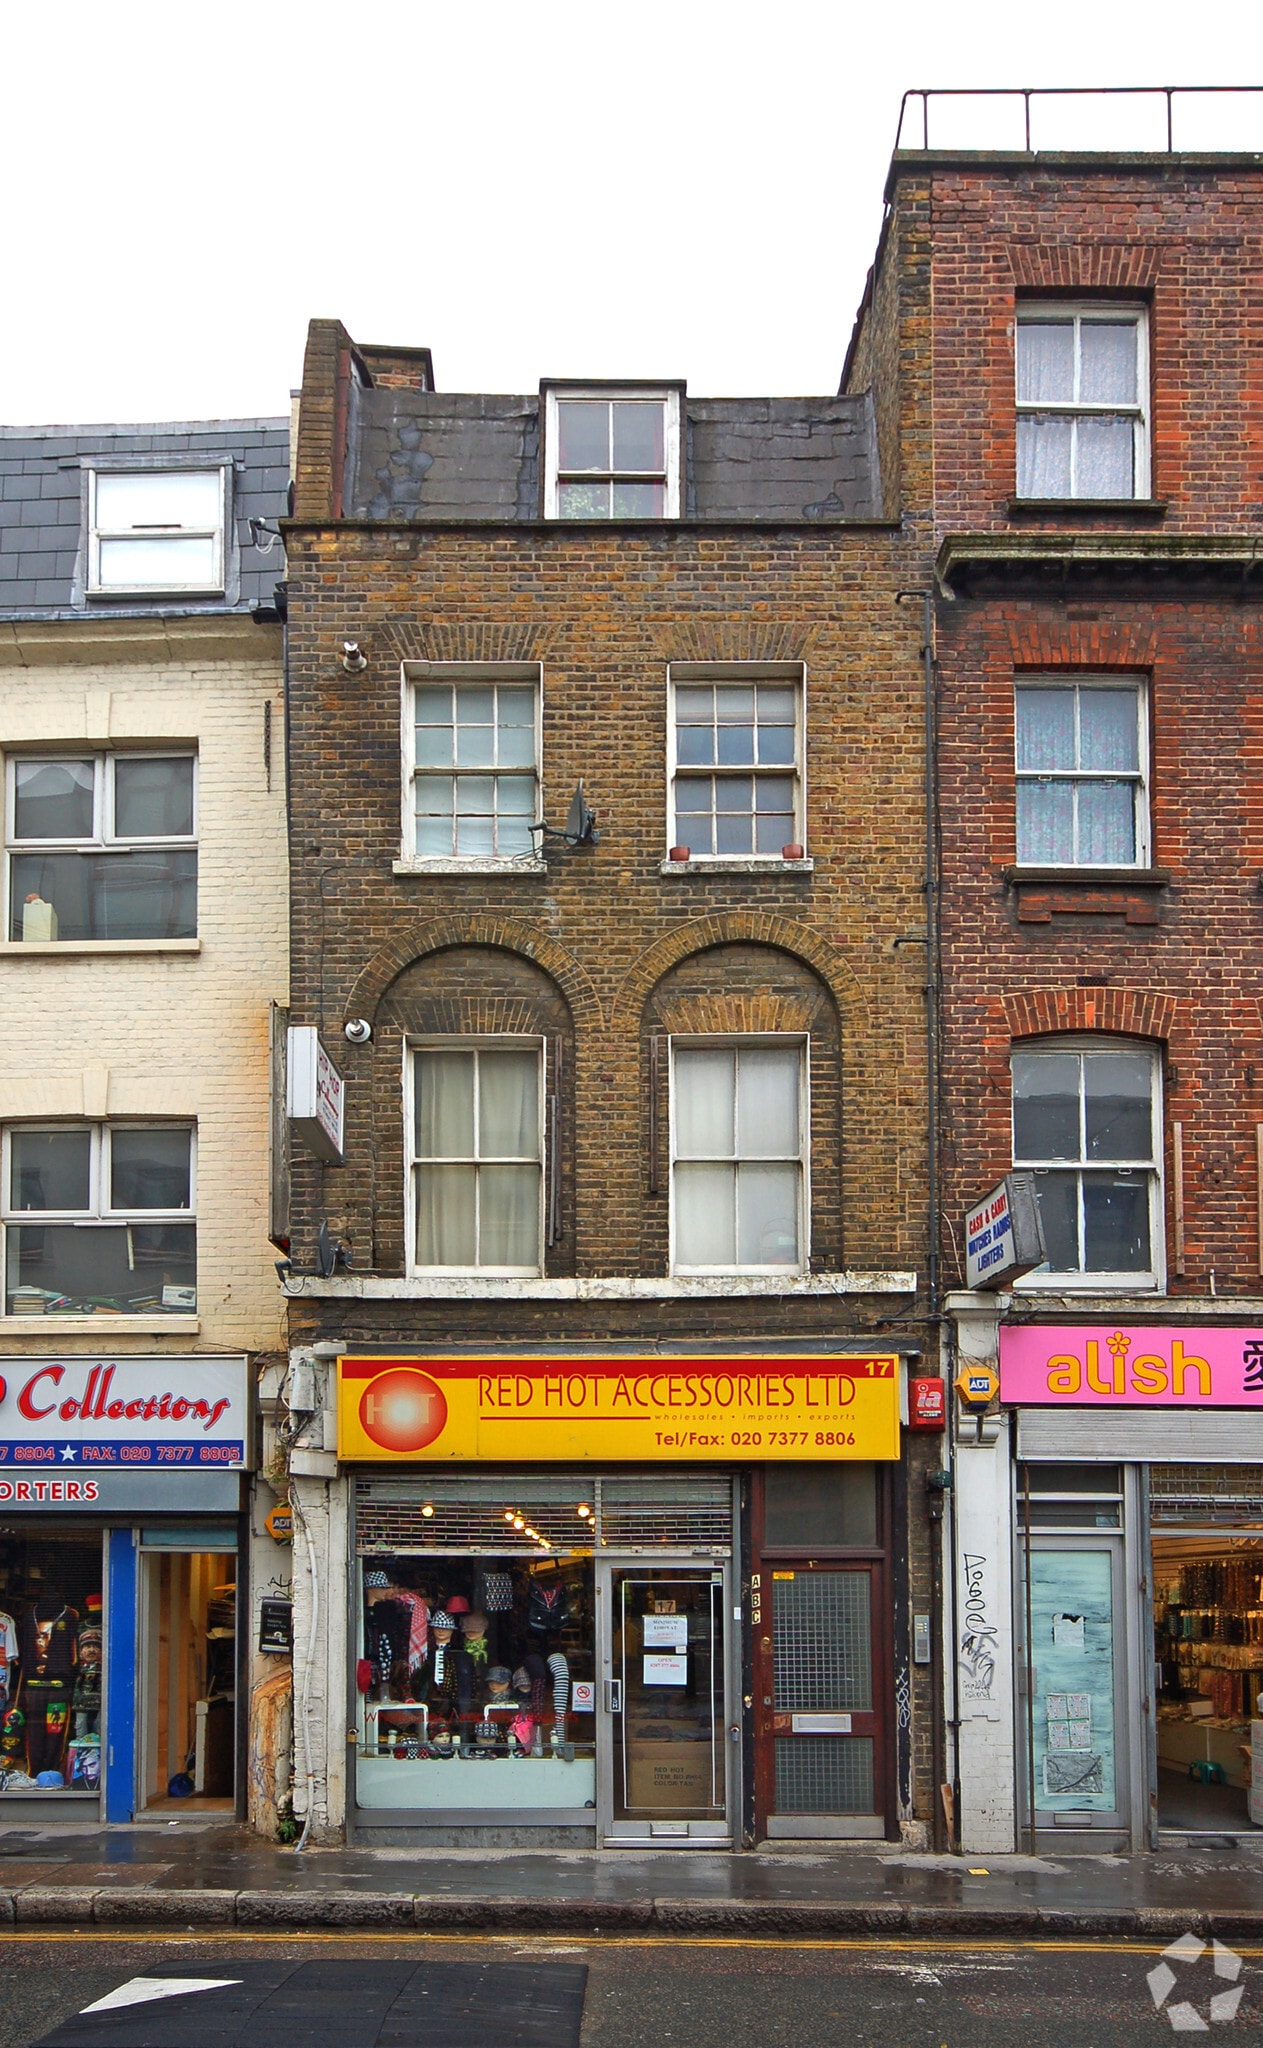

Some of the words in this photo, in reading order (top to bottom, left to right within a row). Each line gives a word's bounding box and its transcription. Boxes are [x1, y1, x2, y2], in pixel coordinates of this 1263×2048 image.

[985, 1208, 990, 1224] &
[864, 1361, 890, 1376] 17
[1046, 1331, 1212, 1396] alish
[478, 1374, 534, 1407] RED
[544, 1373, 606, 1407] HOT
[612, 1373, 795, 1407] ACCESSORIES
[804, 1373, 856, 1407] LTD
[968, 1379, 990, 1391] ADT
[17, 1363, 231, 1431] Collections
[654, 1413, 723, 1422] wholesales
[742, 1413, 790, 1423] imports
[808, 1413, 856, 1423] exports
[655, 1431, 725, 1447] Tel/Fax:
[731, 1432, 761, 1446] 020
[768, 1432, 807, 1446] 7377
[814, 1432, 856, 1446] 8806
[14, 1446, 55, 1460] 8804
[82, 1446, 116, 1460] FAX:
[120, 1446, 151, 1460] 020
[156, 1446, 193, 1460] 7377
[200, 1446, 240, 1461] 8805
[0, 1480, 99, 1501] ORTERS
[273, 1517, 291, 1528] ADT
[753, 1576, 759, 1587] A
[658, 1601, 675, 1612] 17
[753, 1595, 759, 1606] B
[753, 1612, 759, 1623] C
